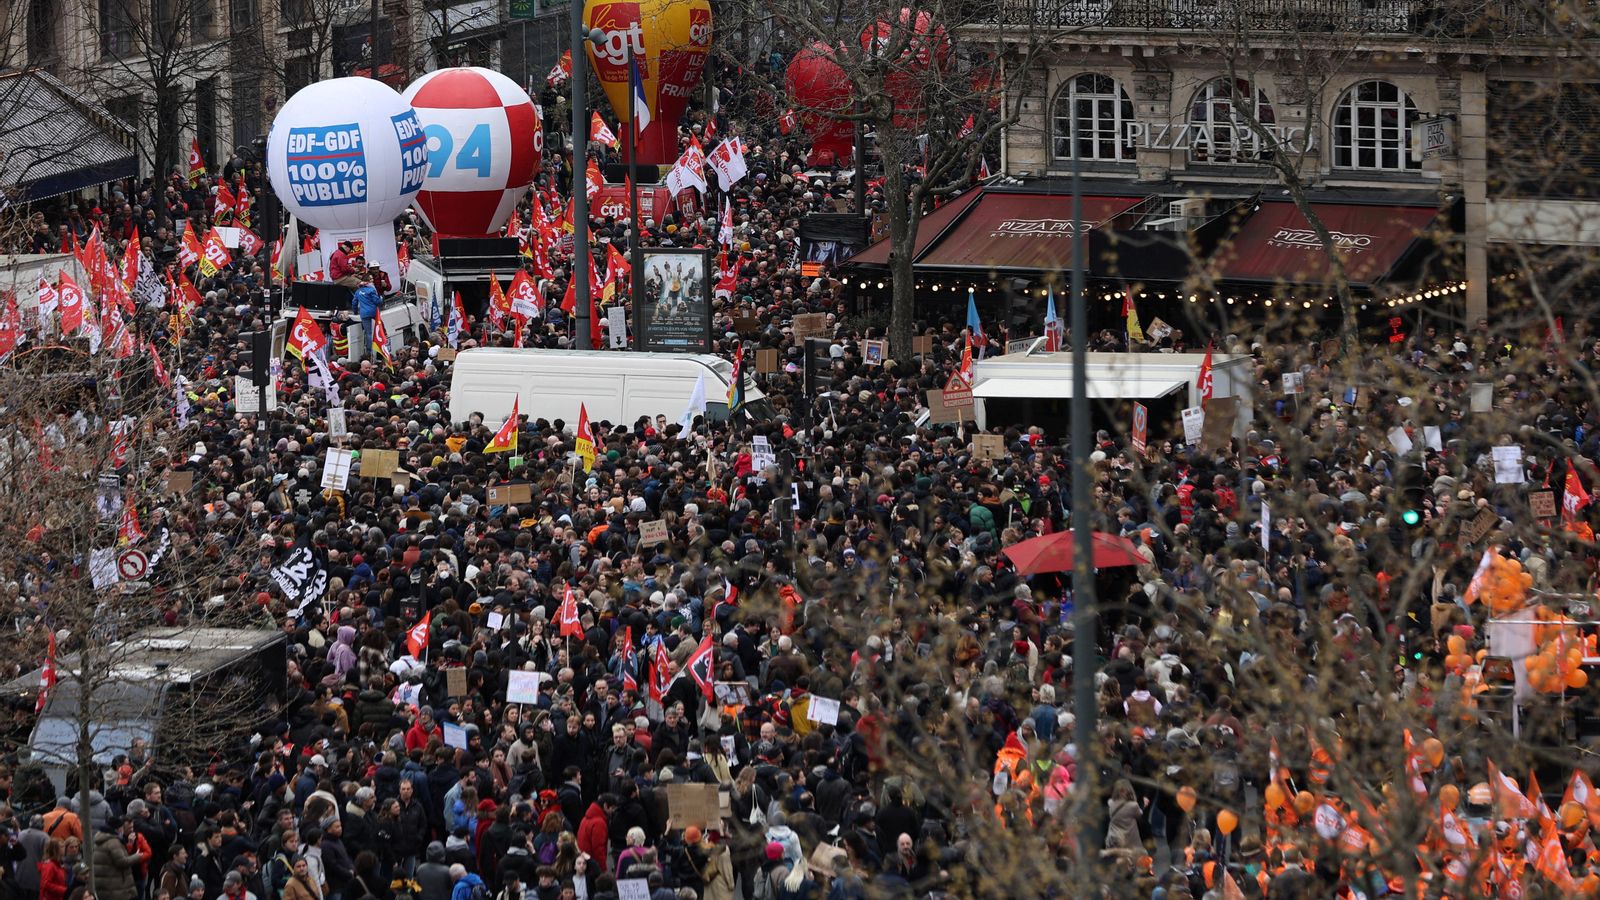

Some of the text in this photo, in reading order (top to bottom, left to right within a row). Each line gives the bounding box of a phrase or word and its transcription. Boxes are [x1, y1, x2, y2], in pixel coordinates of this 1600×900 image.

[1126, 123, 1216, 151] PIZZA
[1427, 123, 1445, 135] PIZZA
[1427, 132, 1445, 147] PINO
[288, 129, 361, 154] EDF-GDF
[423, 123, 492, 178] 94
[288, 160, 365, 182] 100%
[291, 178, 366, 202] PUBLIC
[600, 203, 625, 218] cgt
[998, 221, 1046, 231] PIZZA
